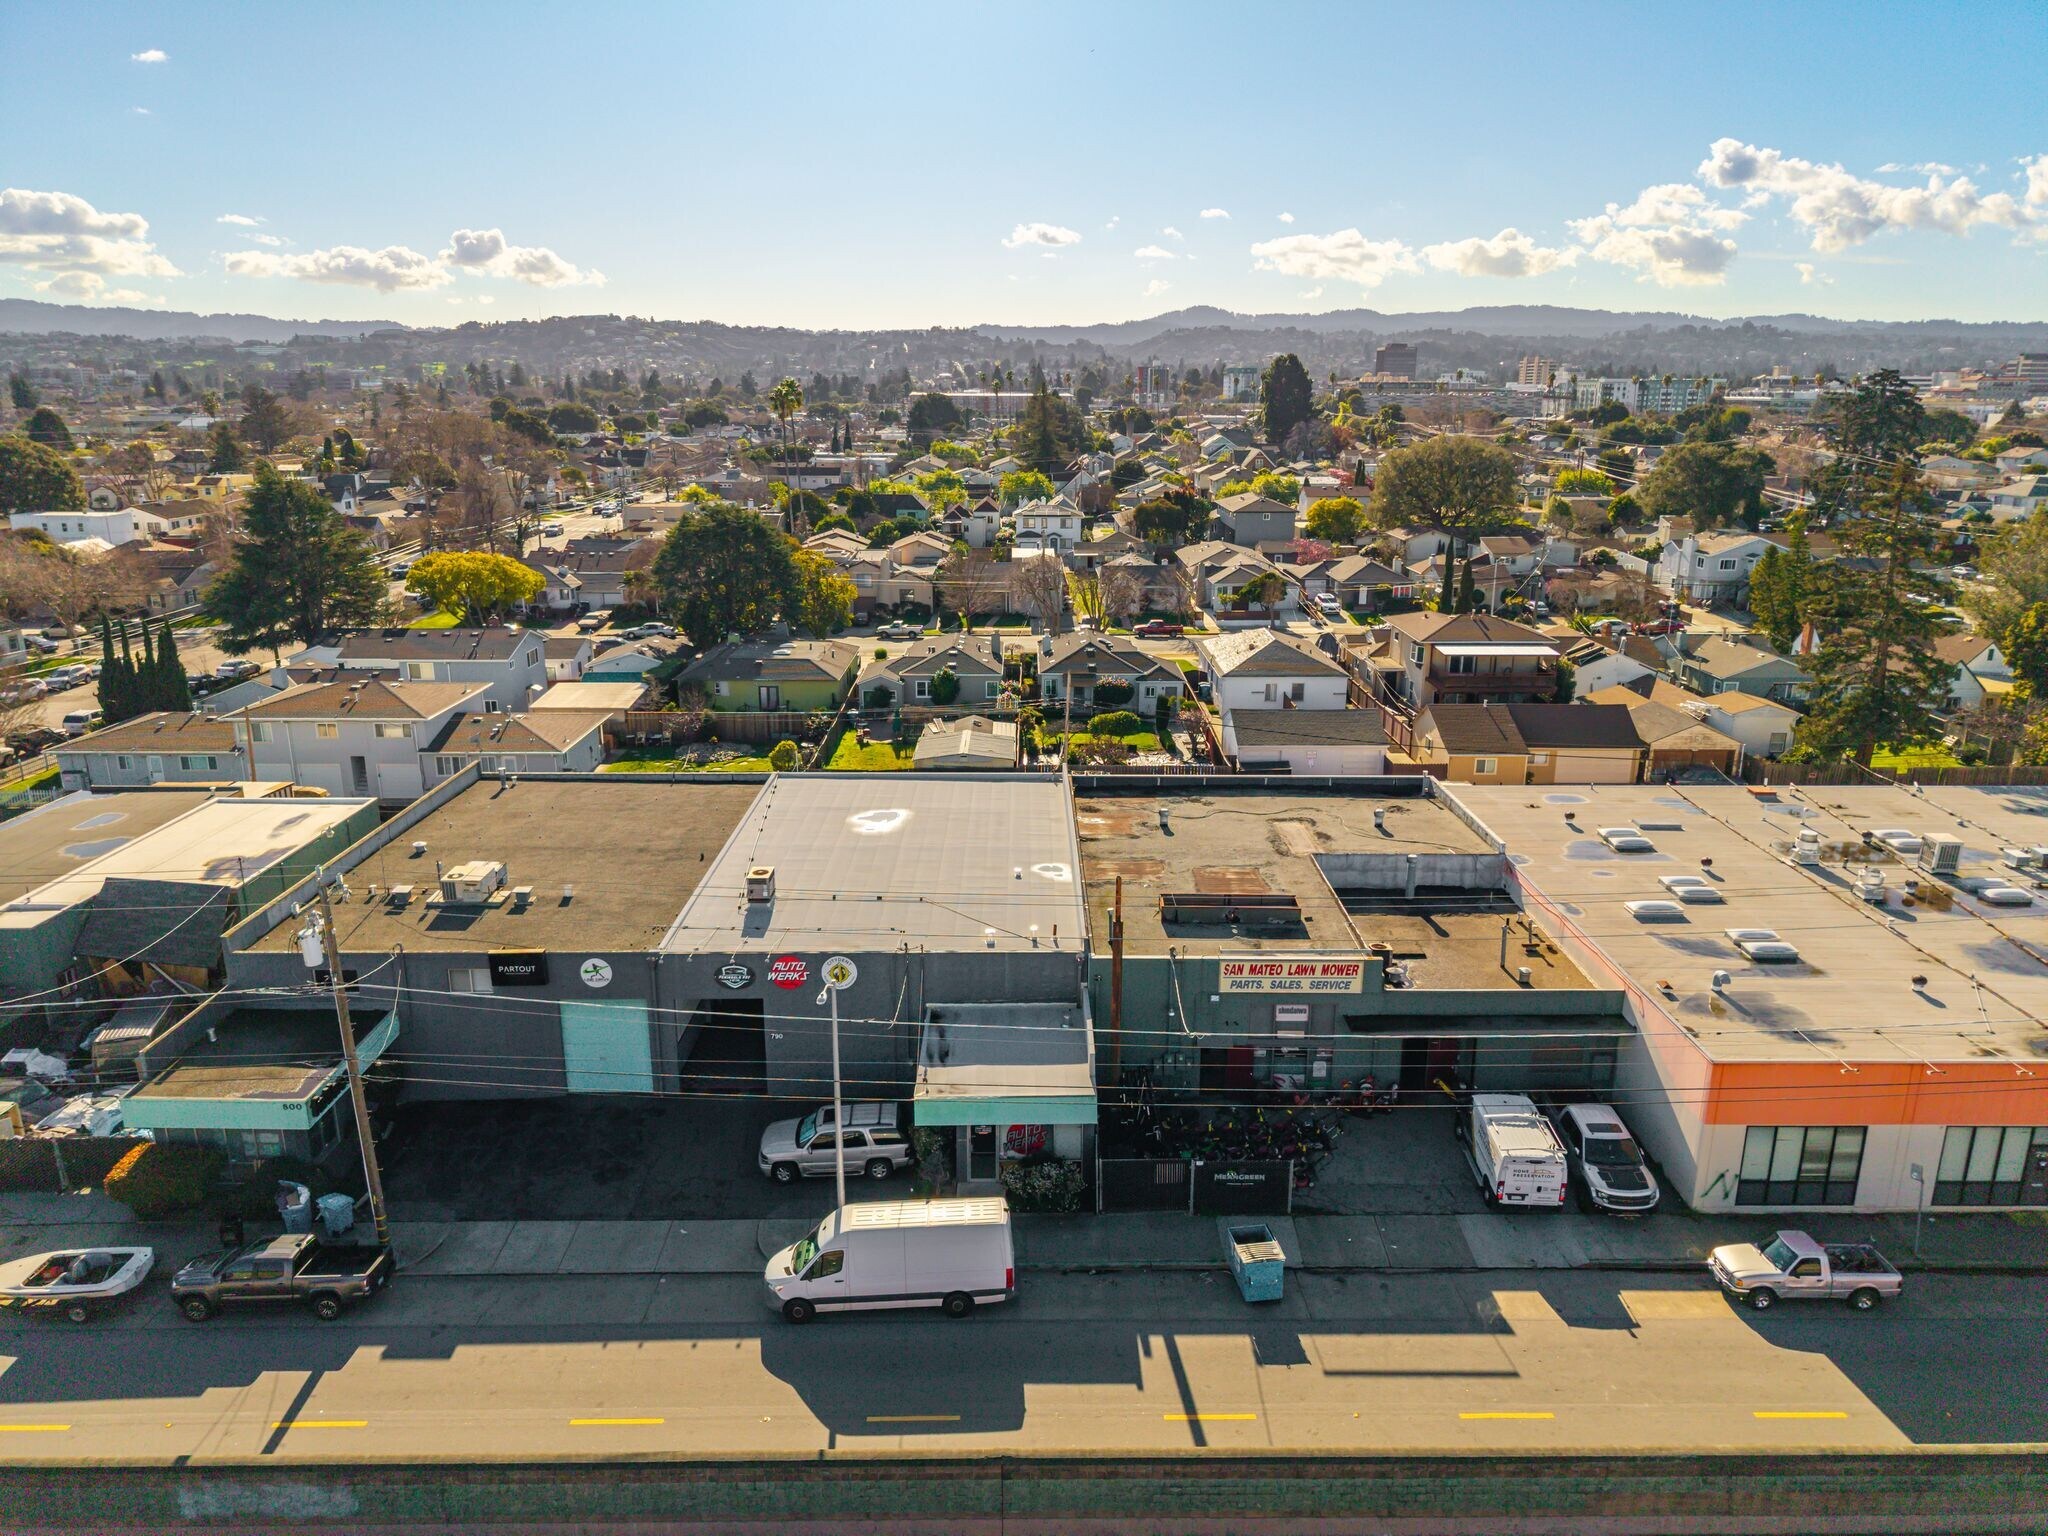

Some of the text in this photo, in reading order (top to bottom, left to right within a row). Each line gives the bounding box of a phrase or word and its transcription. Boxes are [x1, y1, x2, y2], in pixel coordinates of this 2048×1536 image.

[498, 965, 536, 973] PARTOUT
[772, 961, 806, 971] AUTO
[1223, 963, 1360, 976] SAN MATEO LAWN MOWER
[767, 971, 810, 981] WERKS
[1229, 979, 1352, 990] PARTS. SALES. SERVICE
[1007, 1124, 1042, 1140] AUTO
[1002, 1131, 1048, 1153] WERKS
